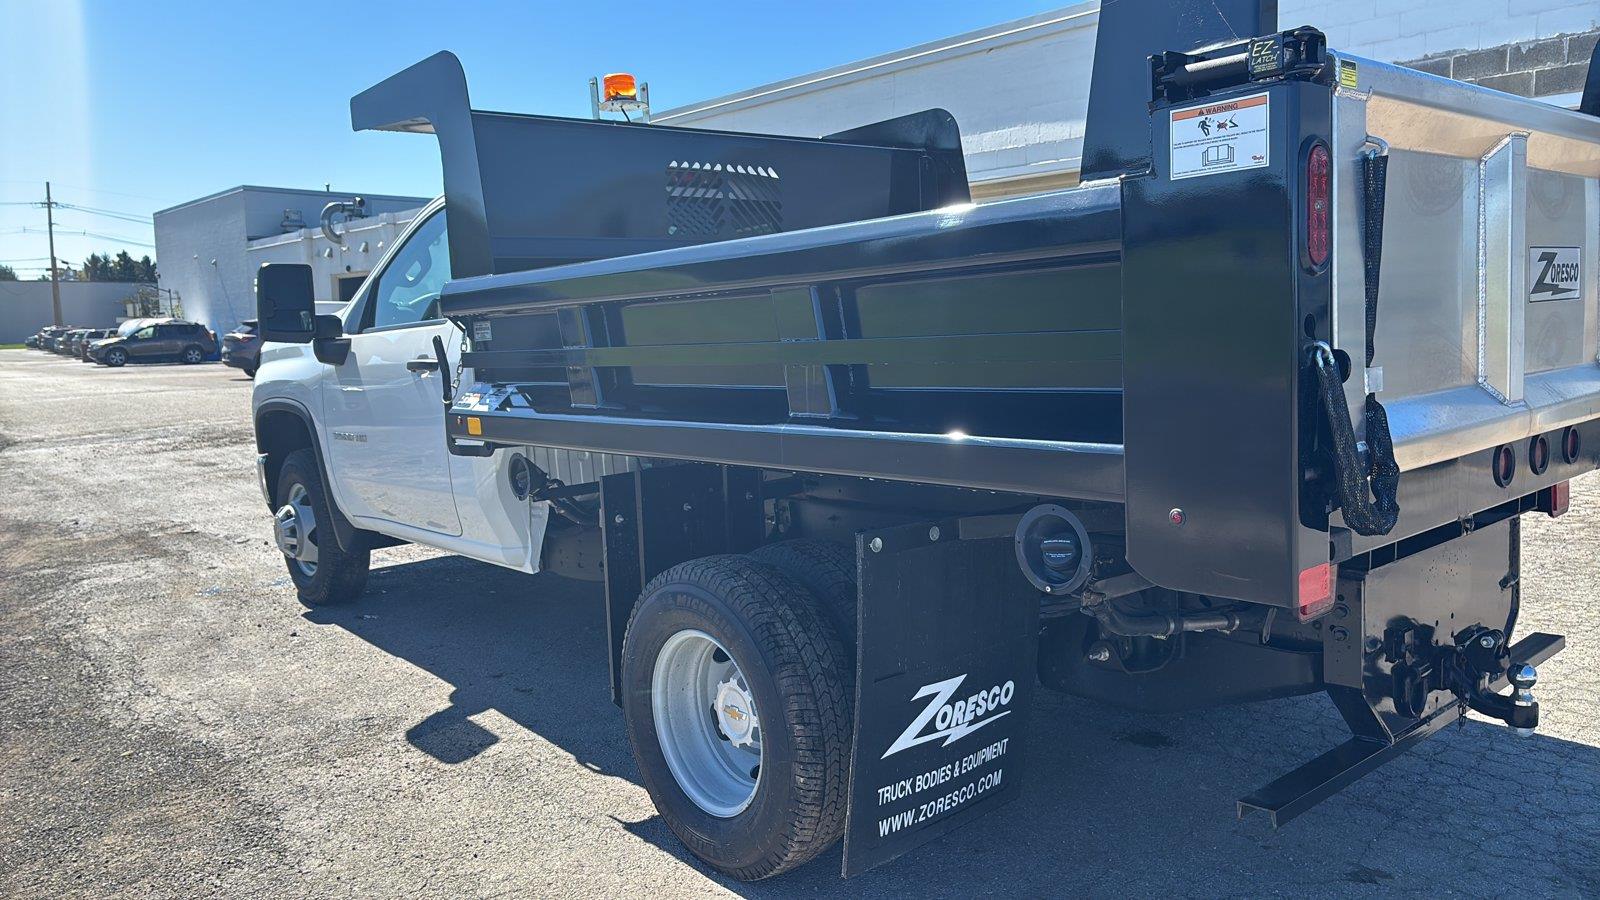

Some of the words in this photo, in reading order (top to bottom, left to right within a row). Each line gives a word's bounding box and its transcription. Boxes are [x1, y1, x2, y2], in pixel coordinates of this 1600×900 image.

[1251, 53, 1277, 66] LATCH
[1252, 40, 1279, 57] EZ-
[1206, 103, 1238, 114] WARNING
[1530, 251, 1579, 296] ZORESCO
[880, 674, 1015, 759] ZORESCO
[877, 777, 914, 806] TRUCK
[915, 764, 952, 793] BODIES
[953, 761, 960, 777] &
[961, 738, 1009, 774] EQUIPMENT
[878, 769, 1003, 838] WWW.ZORESCO.COM
